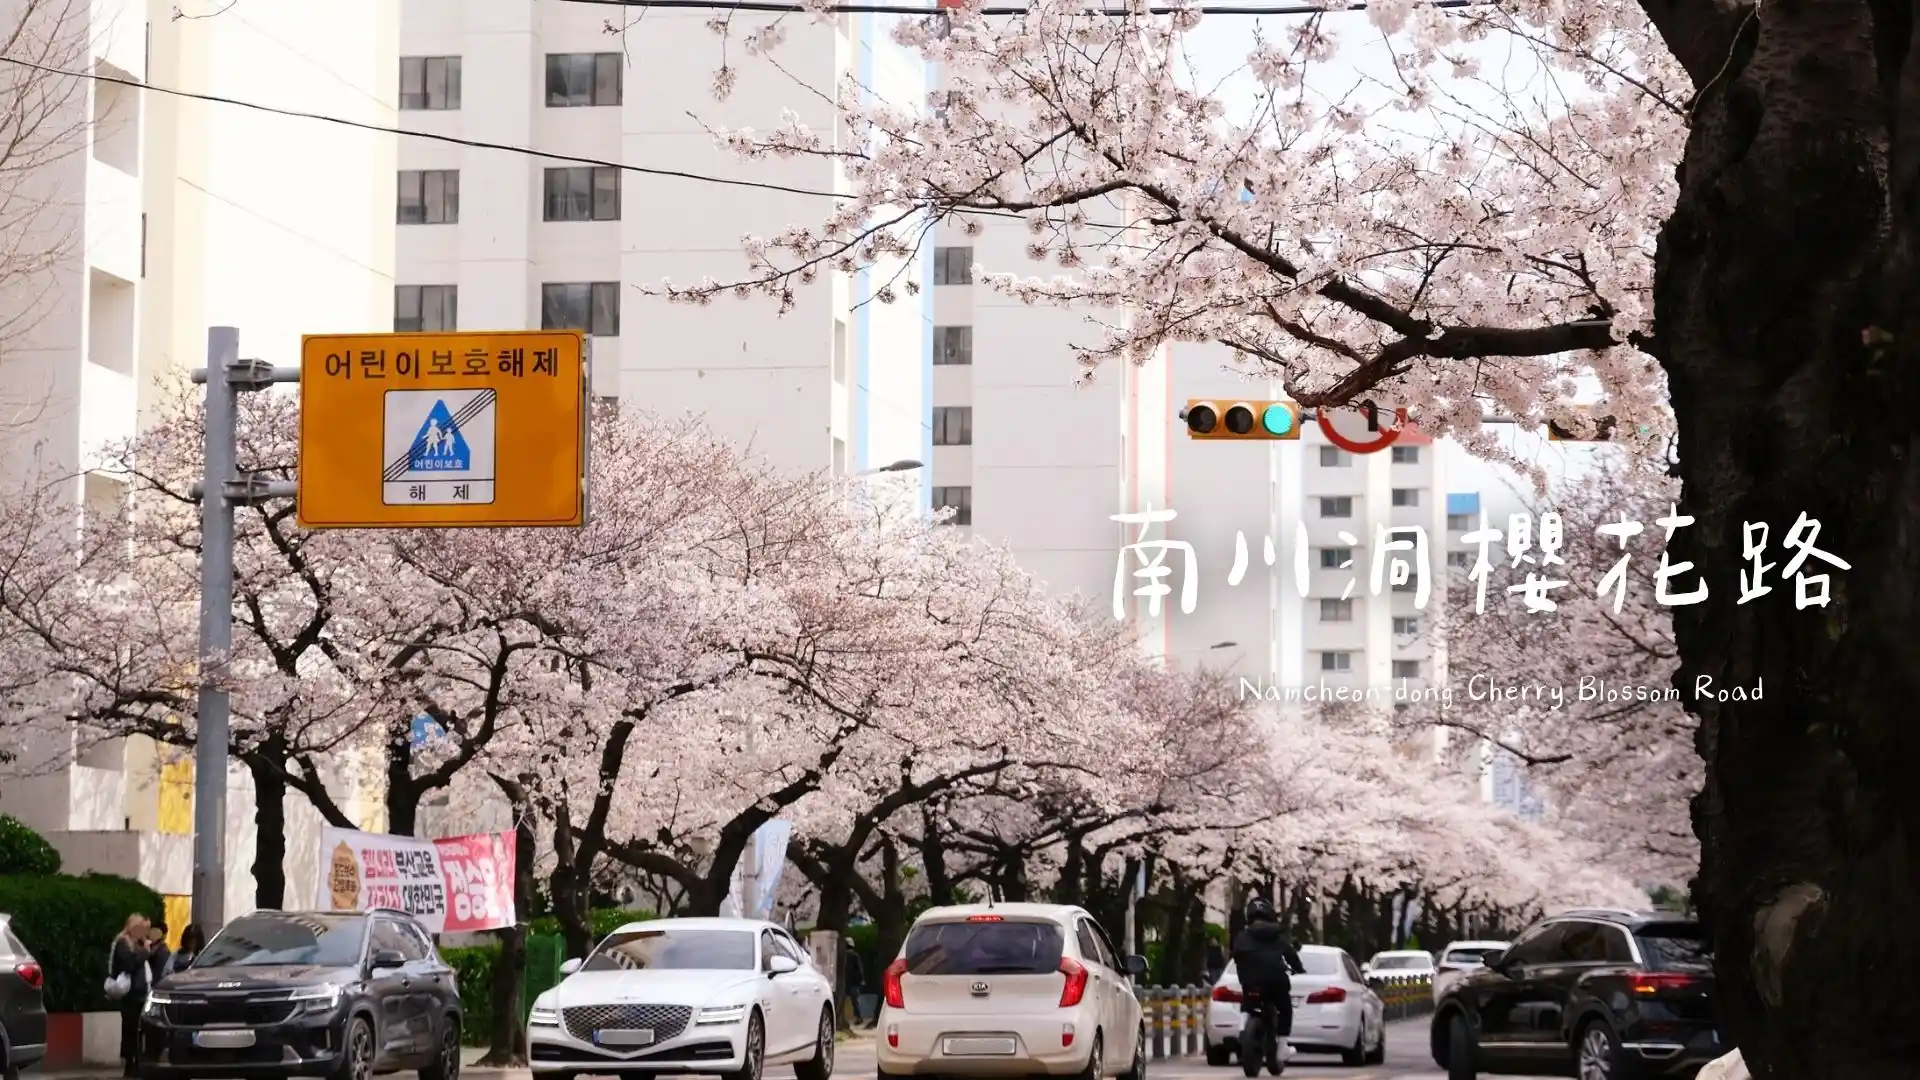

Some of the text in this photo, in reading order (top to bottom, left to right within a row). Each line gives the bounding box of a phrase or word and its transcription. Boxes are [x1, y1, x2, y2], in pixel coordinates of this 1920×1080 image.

[325, 347, 559, 379] 어린이보호해제
[414, 459, 463, 469] 어린이보호
[402, 884, 445, 915] 대한민국
